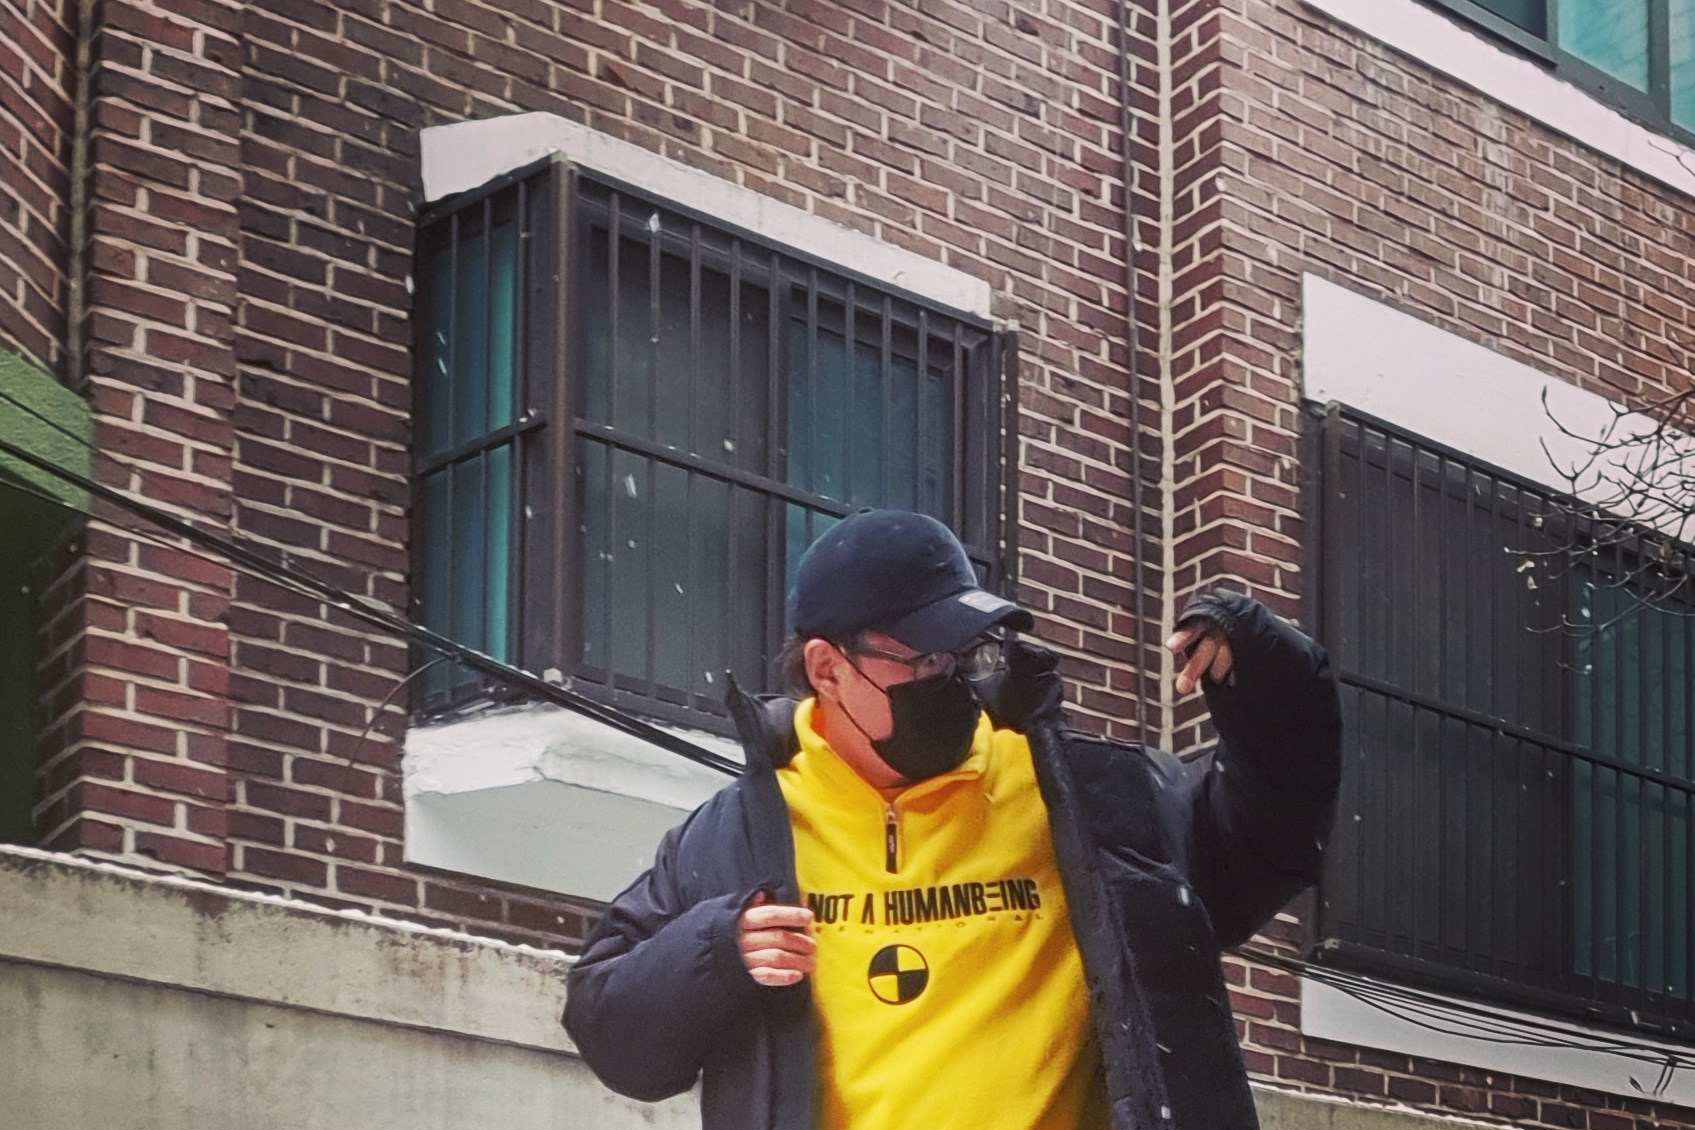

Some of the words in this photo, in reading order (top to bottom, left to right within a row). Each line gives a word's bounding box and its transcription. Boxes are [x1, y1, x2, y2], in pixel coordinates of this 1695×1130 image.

[807, 892, 855, 925] NOT
[861, 892, 875, 925] A
[884, 878, 1042, 926] HUMANBEING
